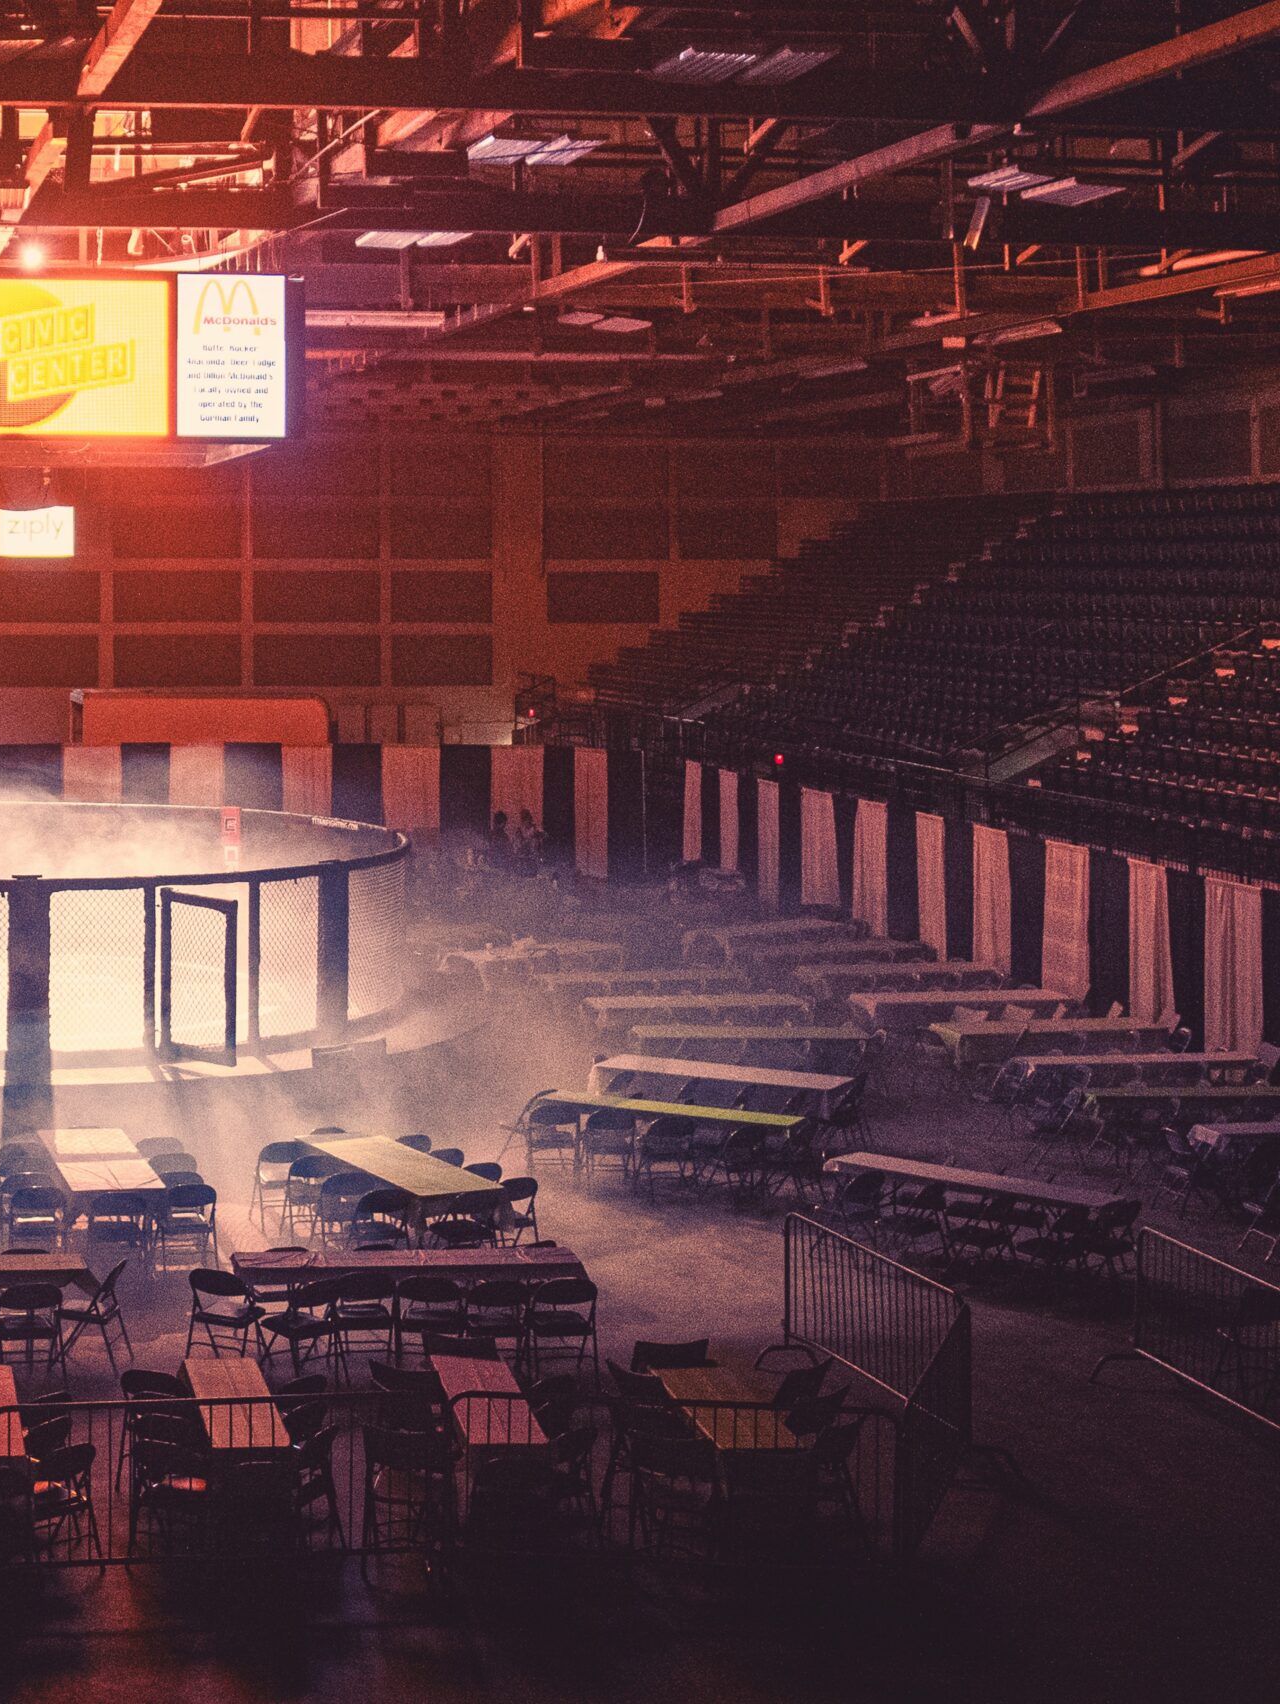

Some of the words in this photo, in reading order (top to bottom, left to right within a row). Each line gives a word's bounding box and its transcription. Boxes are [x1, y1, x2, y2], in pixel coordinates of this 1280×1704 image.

[2, 309, 88, 354] CIVIC
[203, 315, 277, 326] McDonald's
[12, 345, 127, 393] CENTER
[7, 511, 64, 542] ziply
